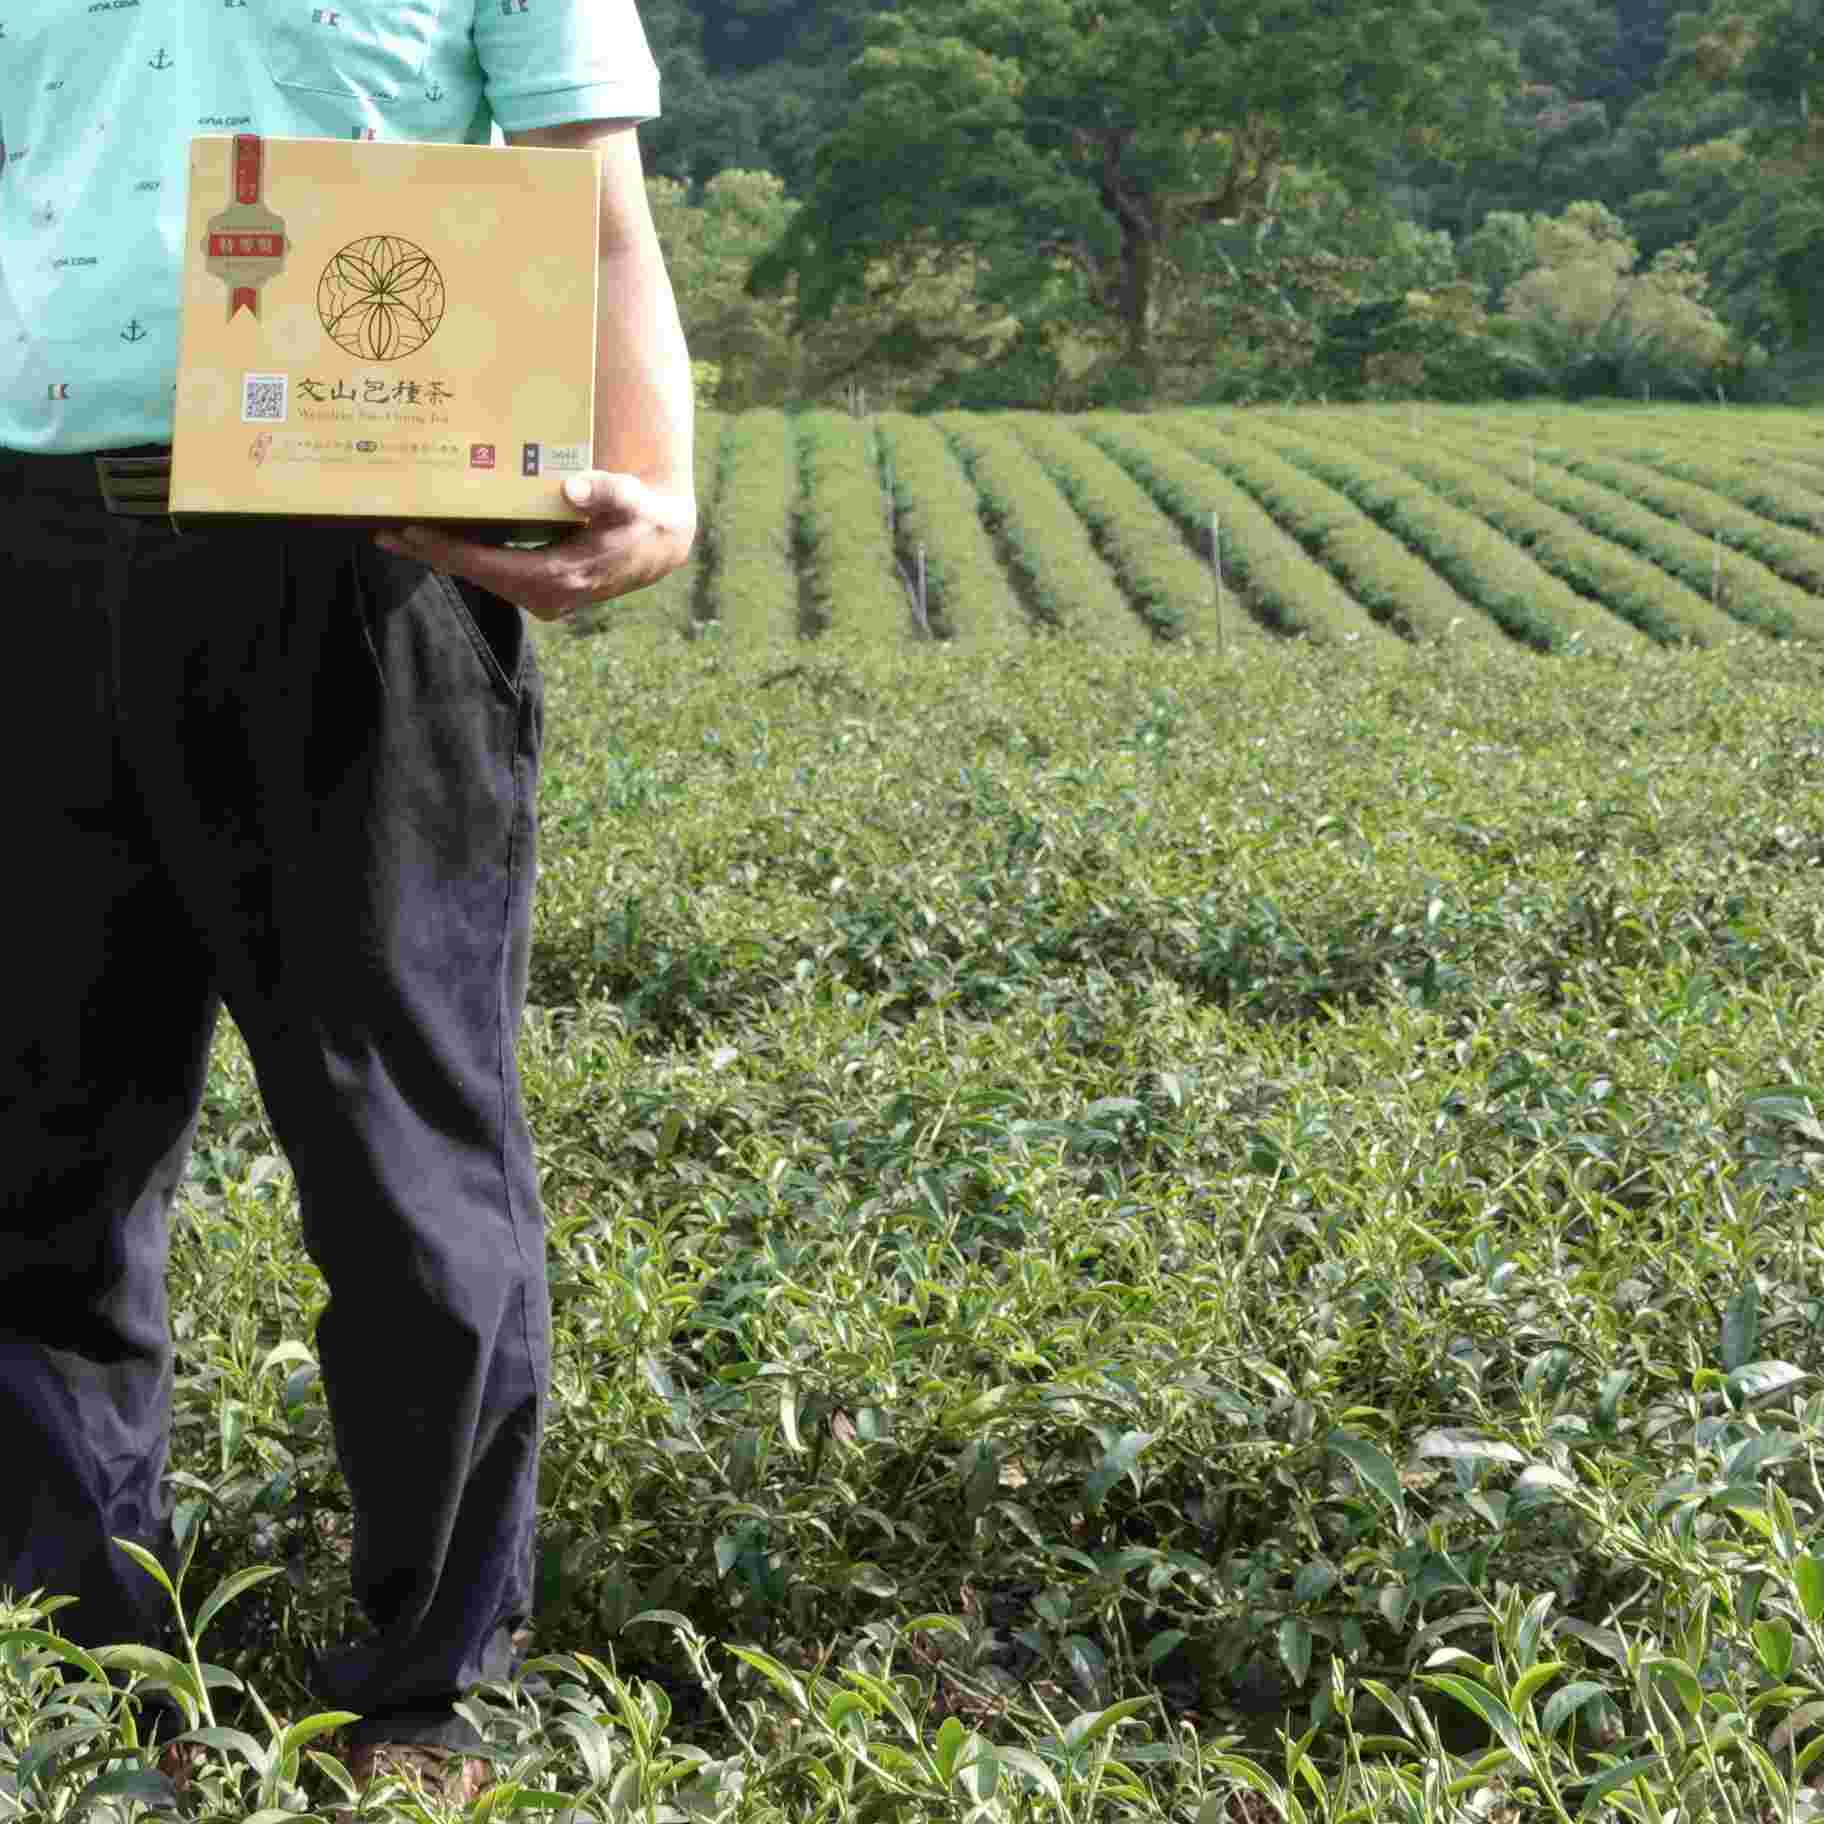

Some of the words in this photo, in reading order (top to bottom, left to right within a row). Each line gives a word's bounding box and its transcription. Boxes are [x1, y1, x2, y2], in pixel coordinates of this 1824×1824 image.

[296, 377, 455, 406] 文山包種茶
